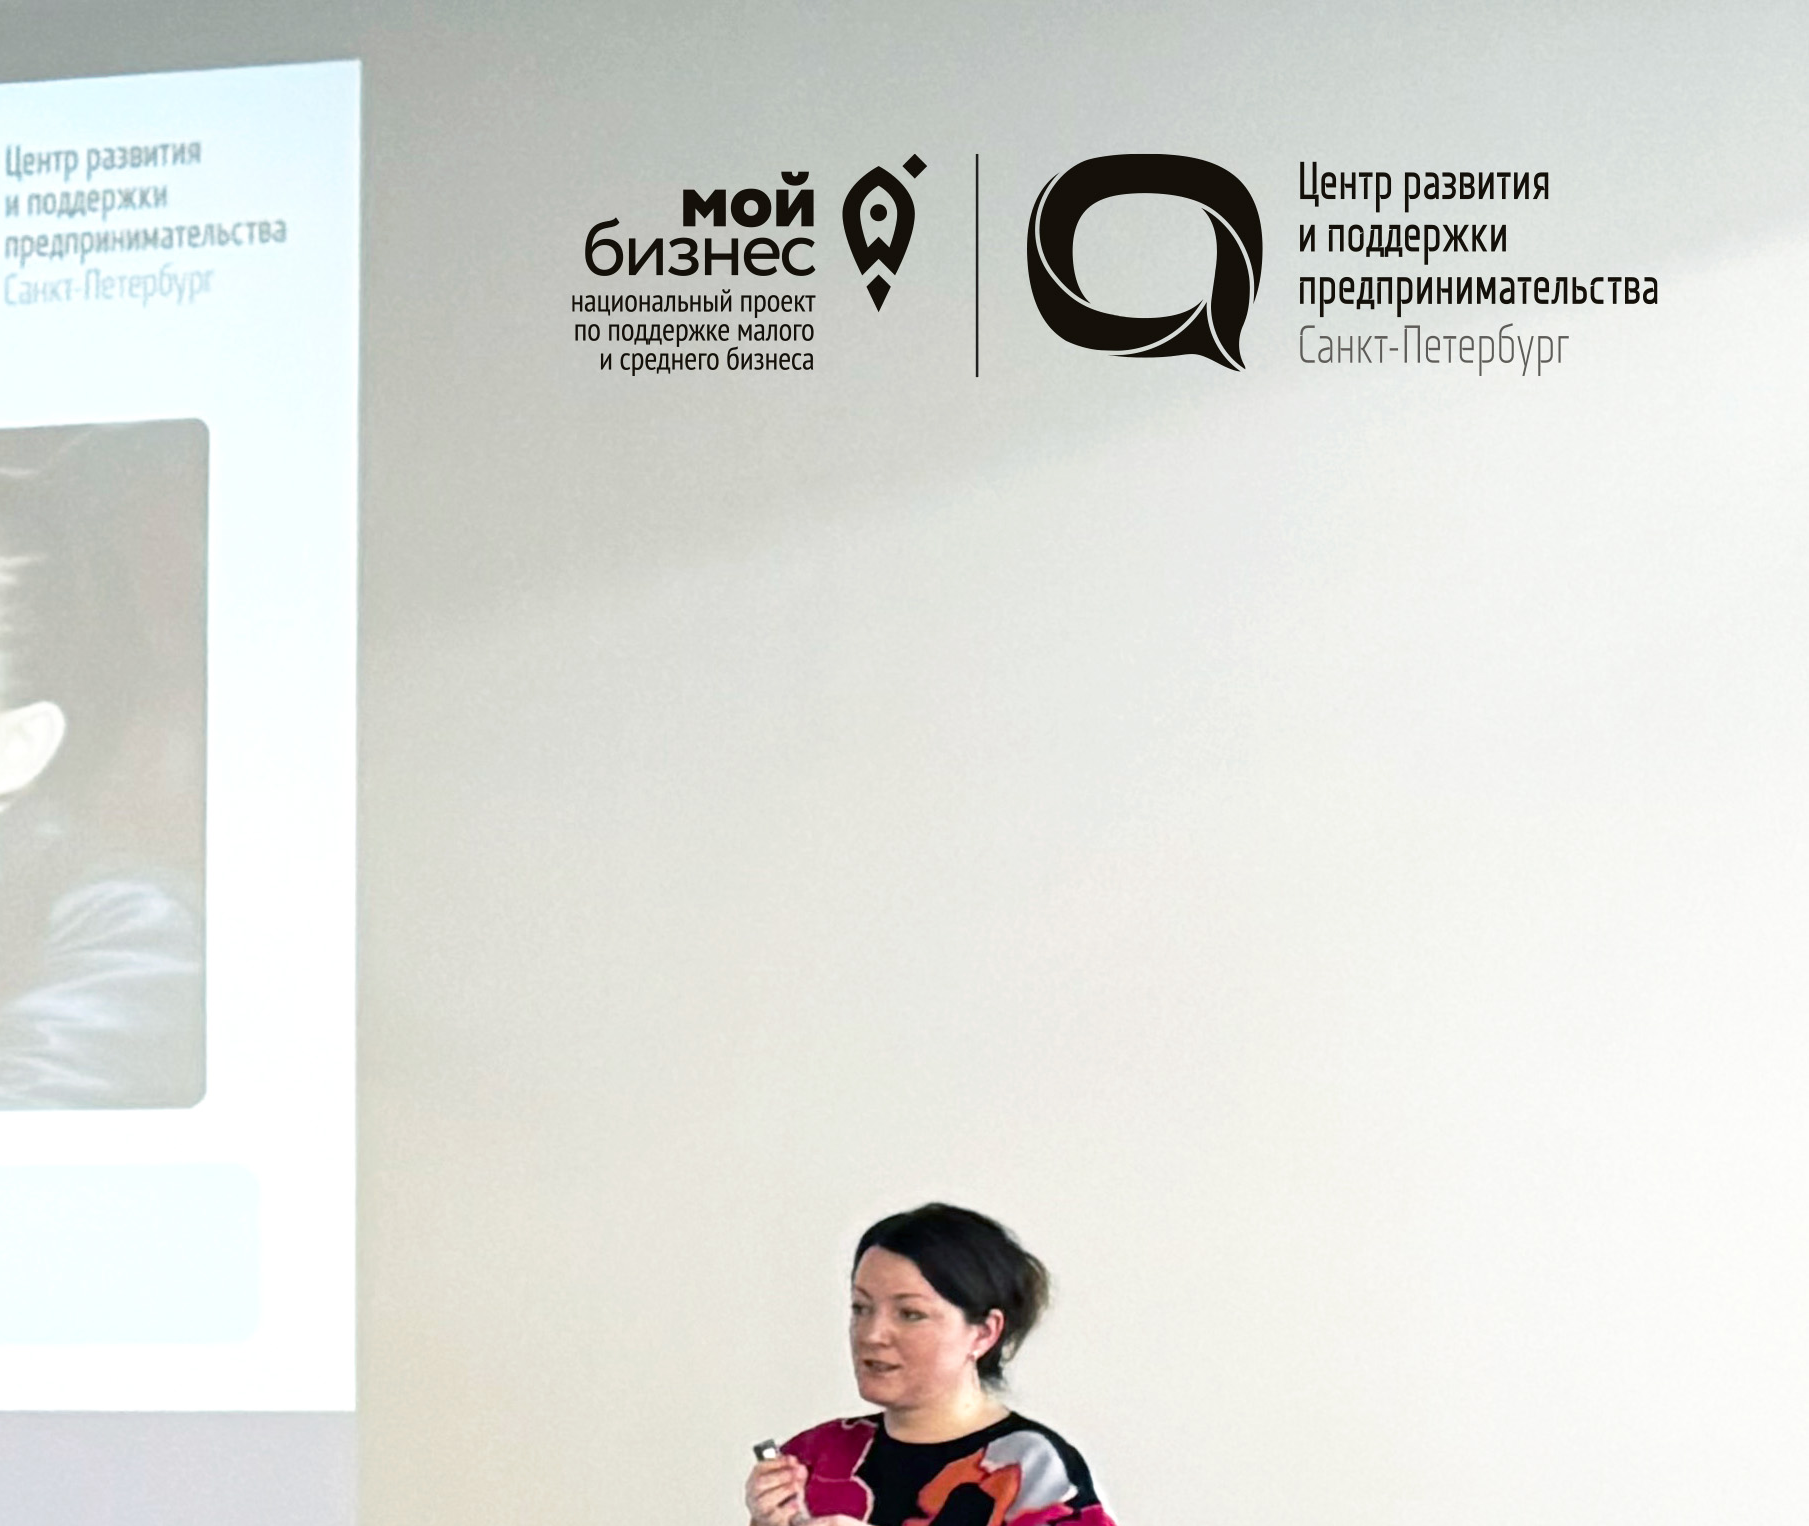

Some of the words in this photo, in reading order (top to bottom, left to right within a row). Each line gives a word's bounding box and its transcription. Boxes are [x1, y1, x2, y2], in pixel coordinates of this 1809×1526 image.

[5, 145, 79, 181] Центр
[86, 142, 202, 181] развития
[4, 195, 20, 217] и
[27, 185, 168, 220] поддержки
[4, 219, 287, 267] предпринимательства
[3, 263, 215, 307] Санкт-Петербург
